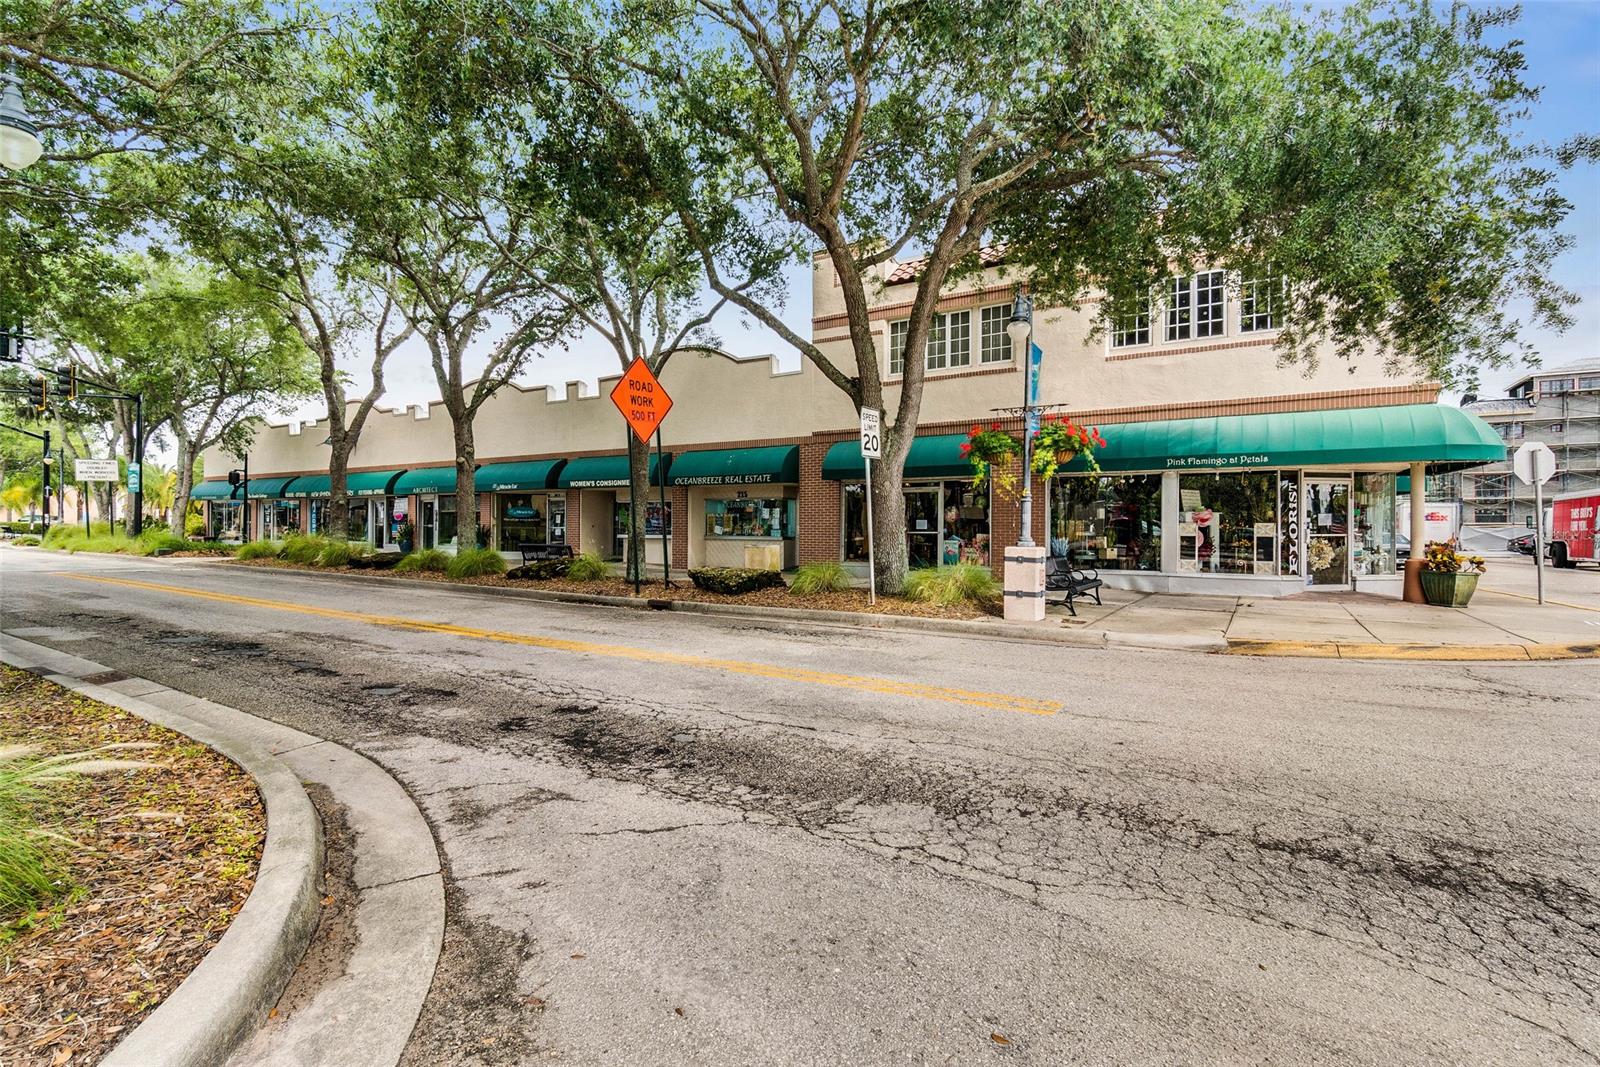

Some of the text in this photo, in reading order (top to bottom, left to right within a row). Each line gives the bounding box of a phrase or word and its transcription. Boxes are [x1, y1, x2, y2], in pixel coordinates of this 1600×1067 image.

[629, 379, 653, 393] ROAD
[630, 394, 654, 407] WORK
[631, 410, 656, 422] 500 FT
[862, 412, 878, 423] SPEED
[863, 433, 879, 452] 20
[1166, 454, 1269, 467] Pink Flamingo at Petals
[569, 480, 595, 488] WOMEN'S
[674, 474, 772, 486] OCEANBREEZE REAL ESTATE
[1288, 483, 1298, 574] FLORIST
